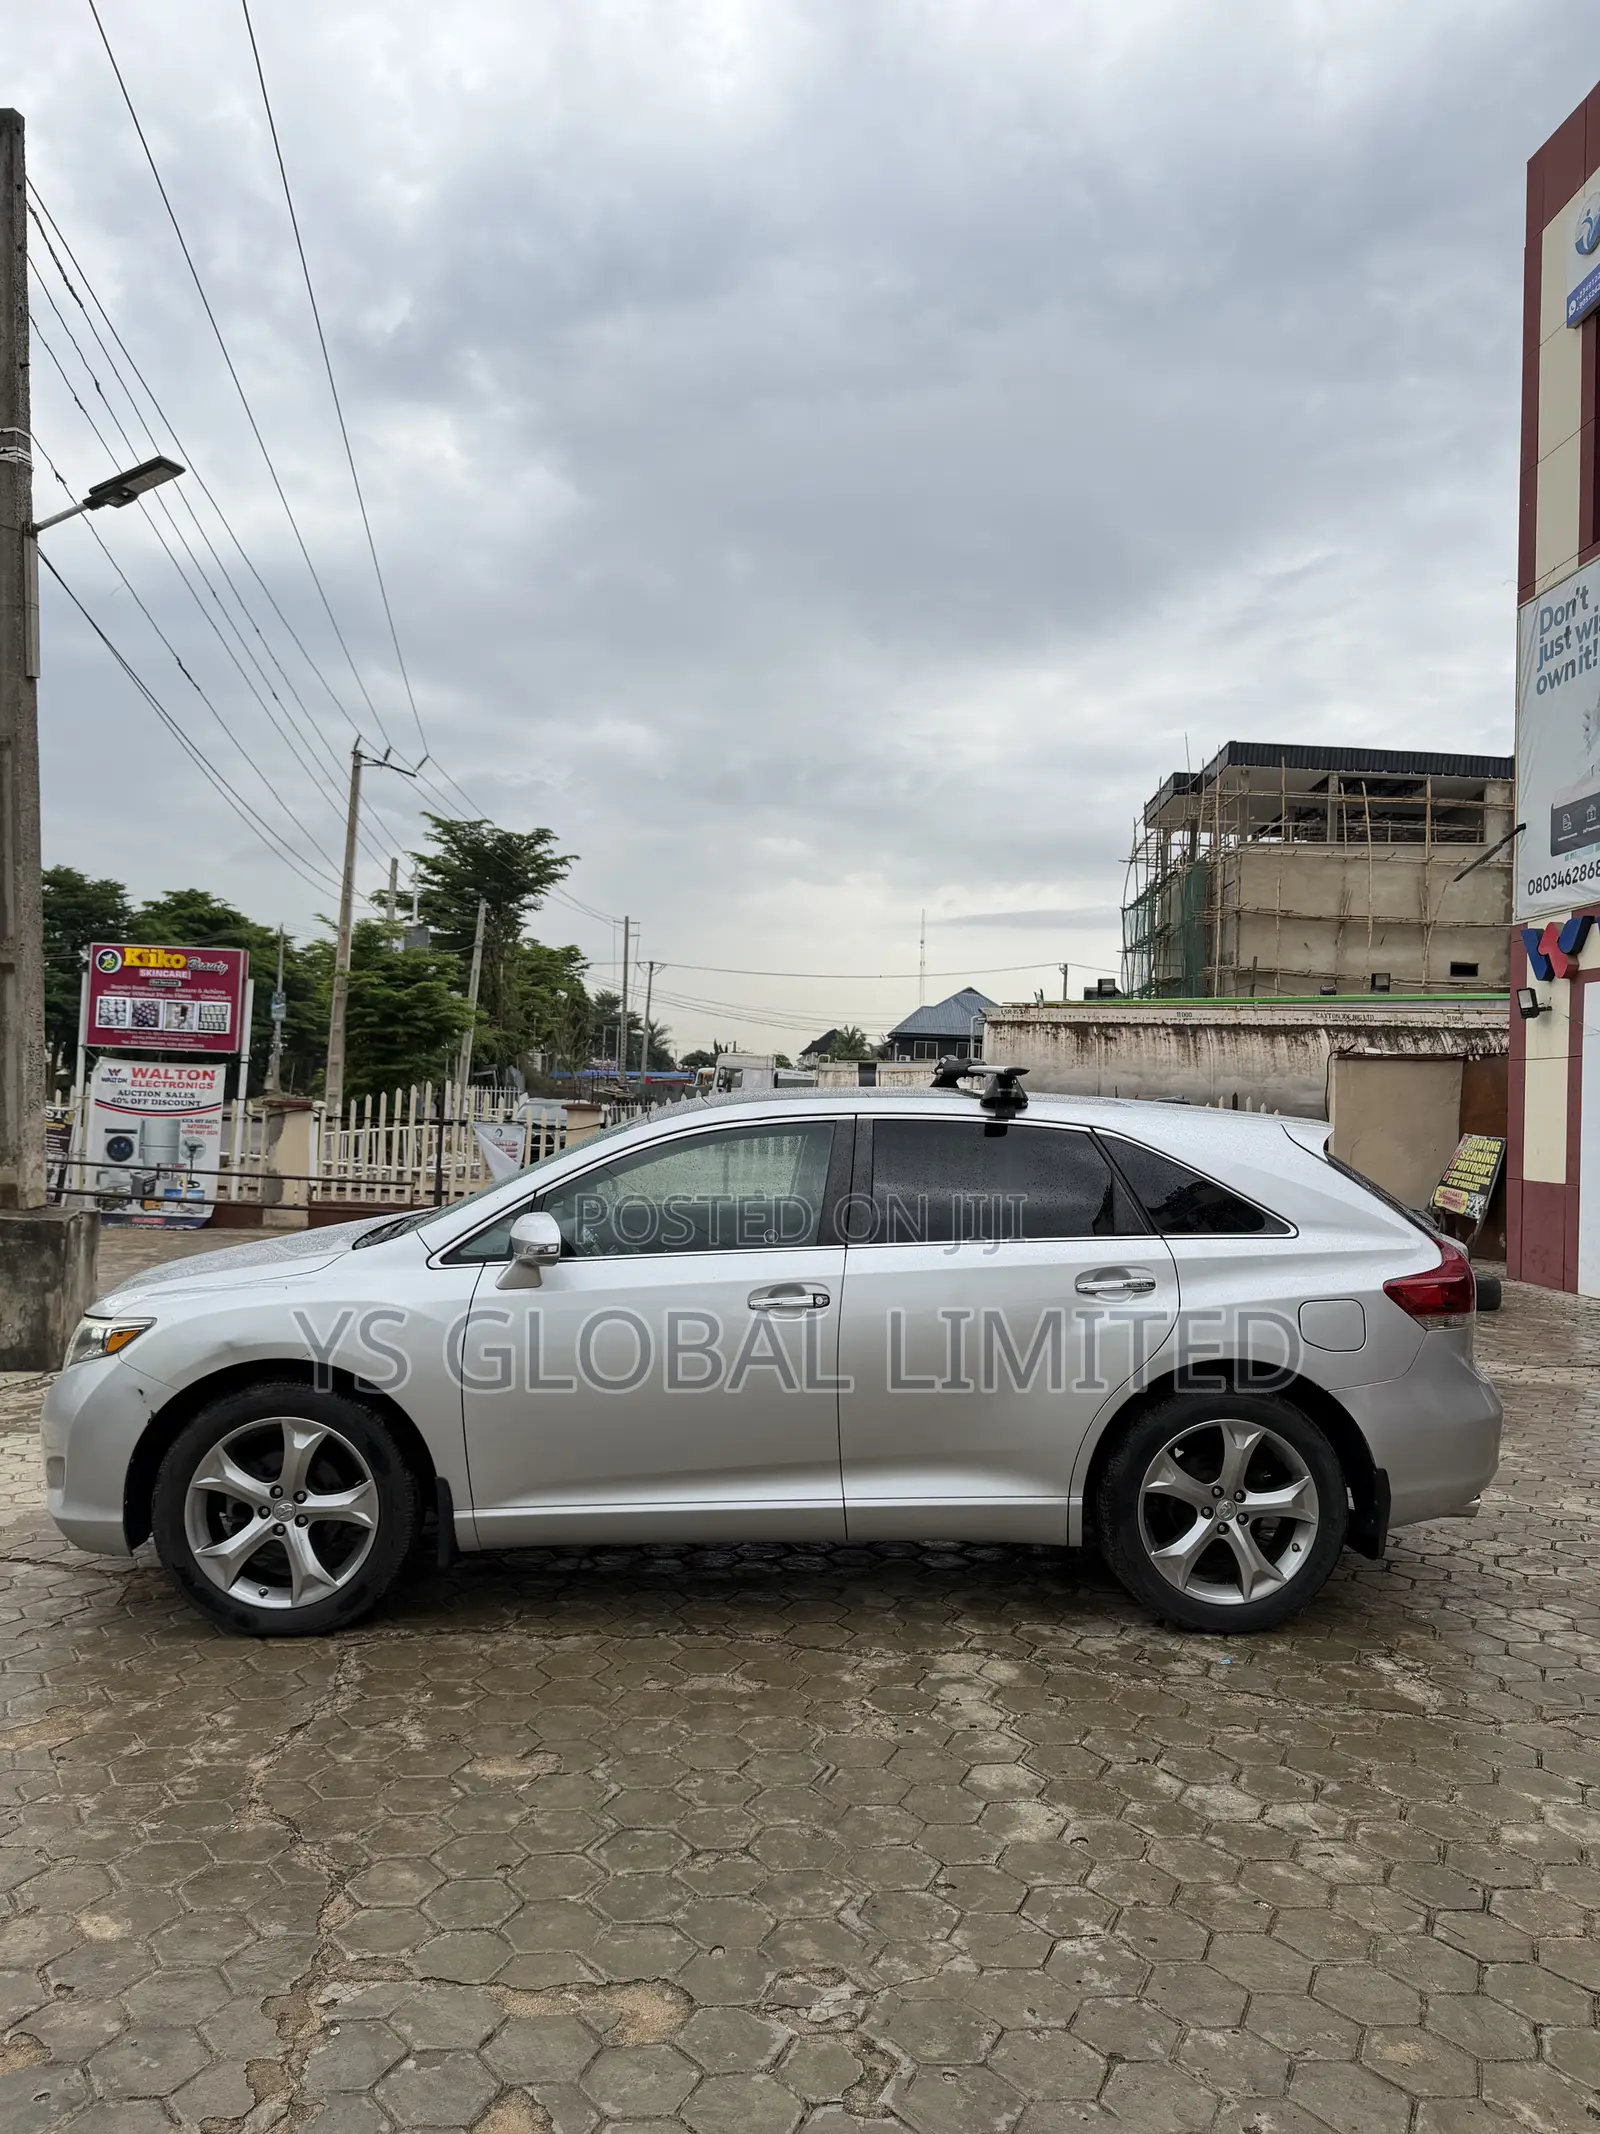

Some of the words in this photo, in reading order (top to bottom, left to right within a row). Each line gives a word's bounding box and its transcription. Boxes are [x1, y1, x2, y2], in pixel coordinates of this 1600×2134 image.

[1540, 585, 1589, 636] Don't
[1536, 625, 1572, 673] just
[1575, 604, 1600, 643] wi
[1536, 658, 1576, 696] own
[1578, 638, 1599, 675] it!
[187, 956, 229, 976] Beauty
[139, 969, 188, 979] SKINCARE
[131, 1067, 216, 1081] WALTON
[130, 1080, 215, 1090] ELECTRONICS
[117, 1089, 161, 1098] AUCTION
[165, 1091, 196, 1099] SALES
[110, 1097, 129, 1105] 40%
[131, 1097, 150, 1105] OFF
[151, 1098, 203, 1107] DISCOUNT
[1465, 1138, 1502, 1152] PRINTING
[1460, 1149, 1498, 1165] SCANING
[1454, 1159, 1495, 1176] PHOTOCOPY
